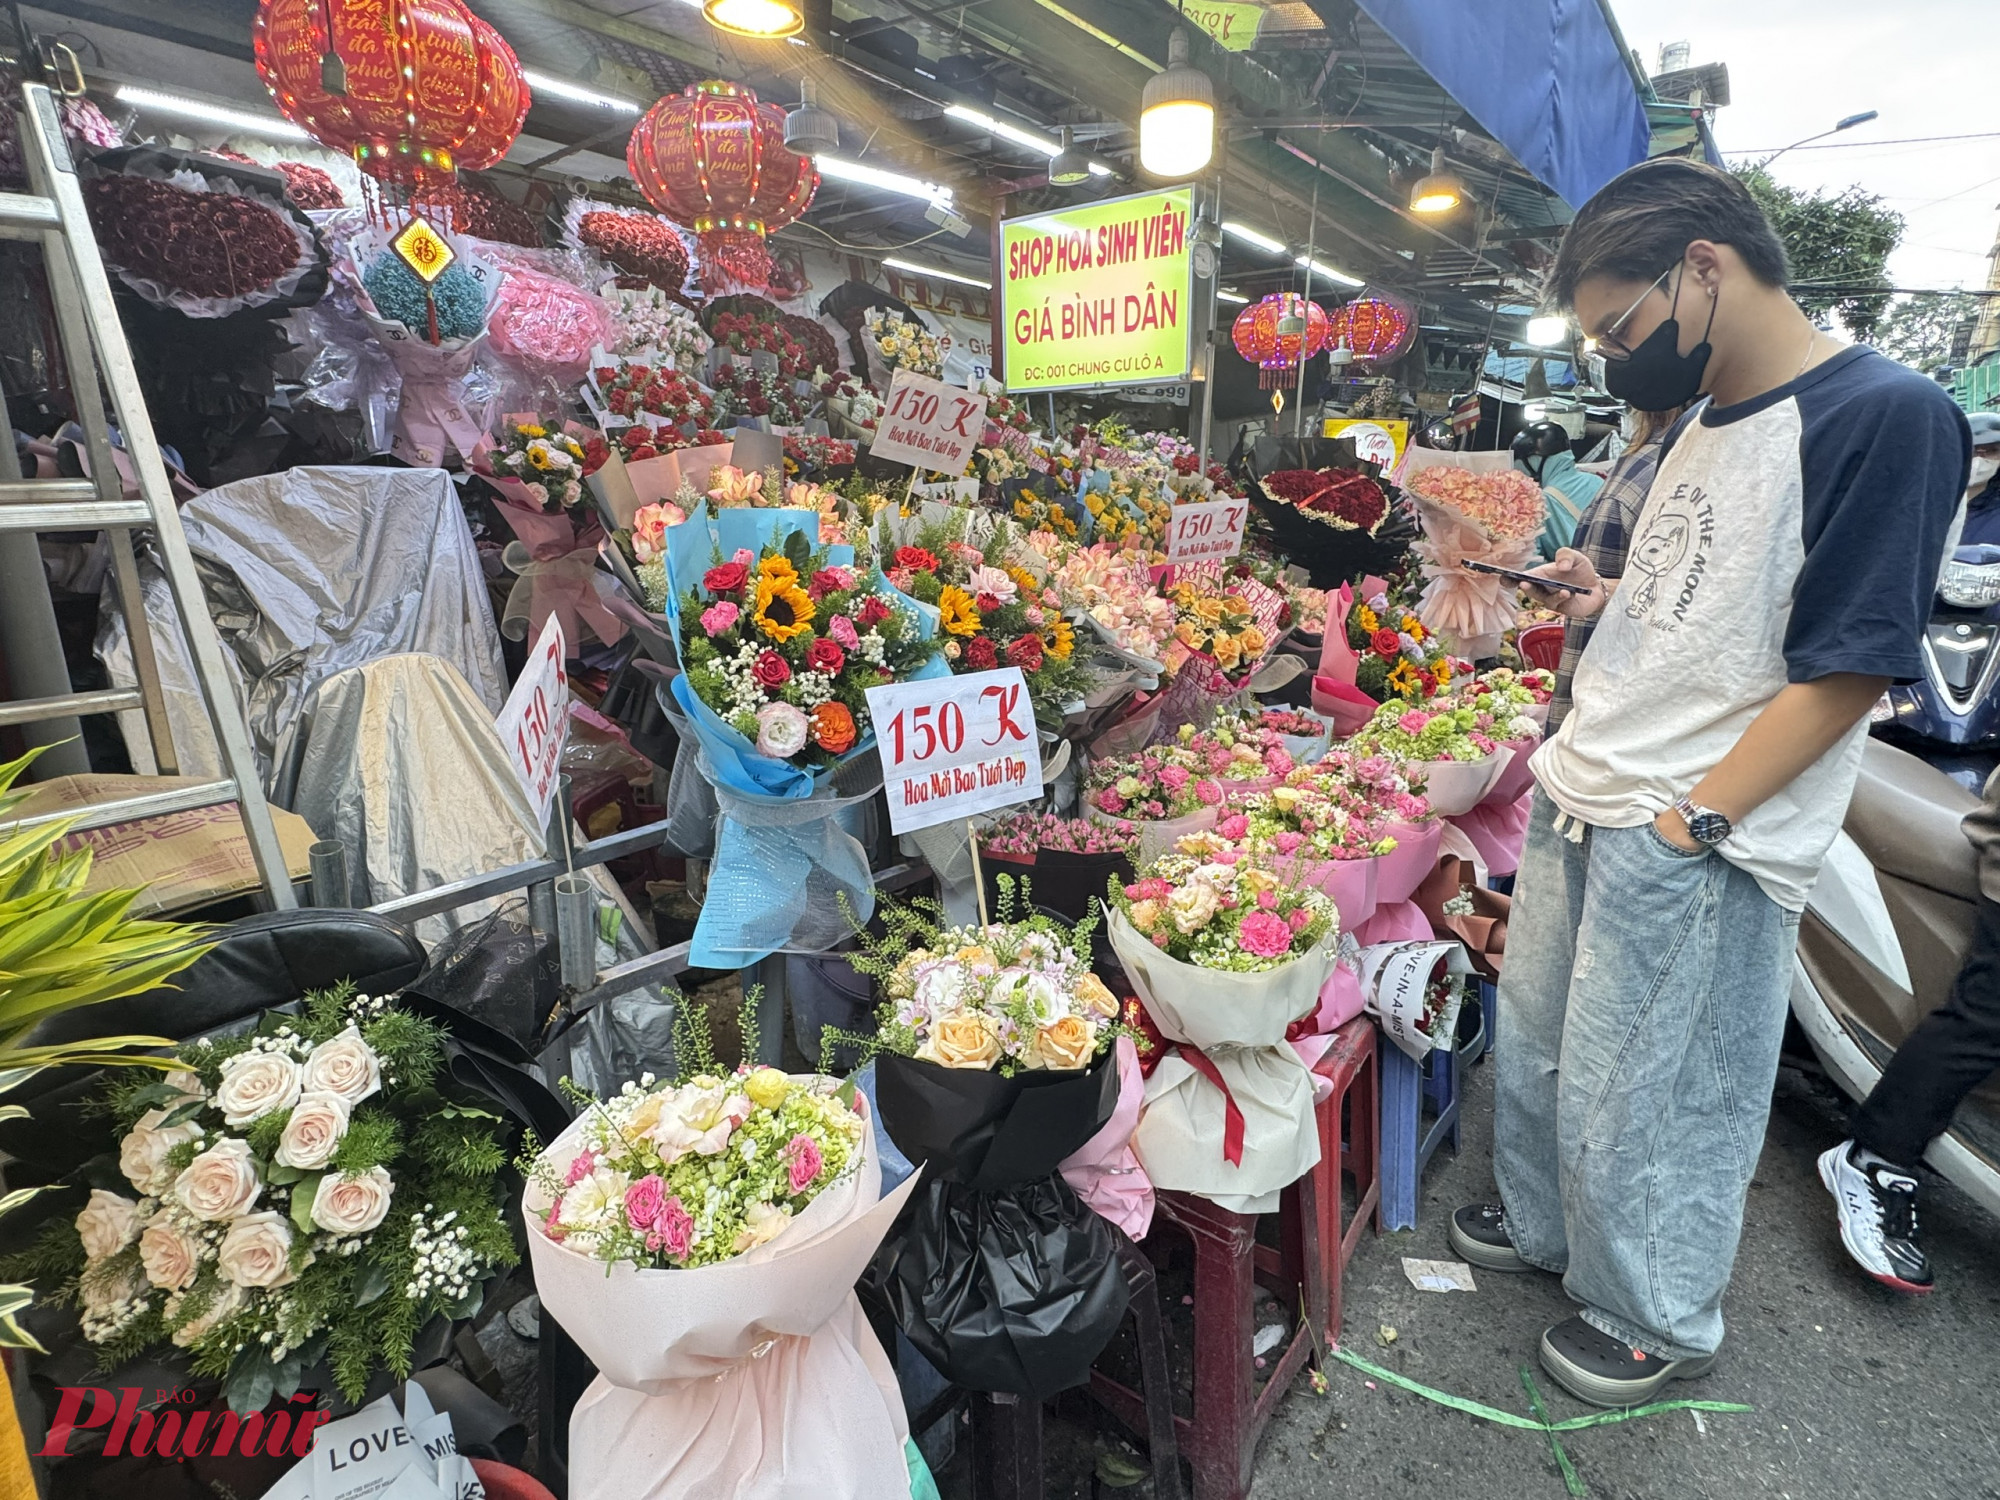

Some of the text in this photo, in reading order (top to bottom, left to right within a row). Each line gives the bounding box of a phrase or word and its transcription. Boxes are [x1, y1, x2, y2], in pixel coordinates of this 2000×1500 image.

[1009, 201, 1186, 281] SHOP HOA SINH VIÊN
[1014, 281, 1178, 345] GIÁ BÌNH DÂN
[1024, 353, 1164, 381] ĐC: 001 CHUNG CƯ LÔ A
[889, 386, 979, 438] 150 K
[888, 425, 906, 443] Hoa
[917, 433, 932, 451] Bao
[946, 442, 962, 461] Đẹp
[1178, 507, 1244, 540] 150 K
[1697, 503, 1714, 550] THE
[1672, 552, 1707, 622] MOON
[517, 685, 549, 779] 150
[887, 683, 1031, 766] 150 K
[903, 778, 929, 807] Hoa
[953, 767, 976, 795] Bao
[1005, 756, 1026, 787] Đẹp
